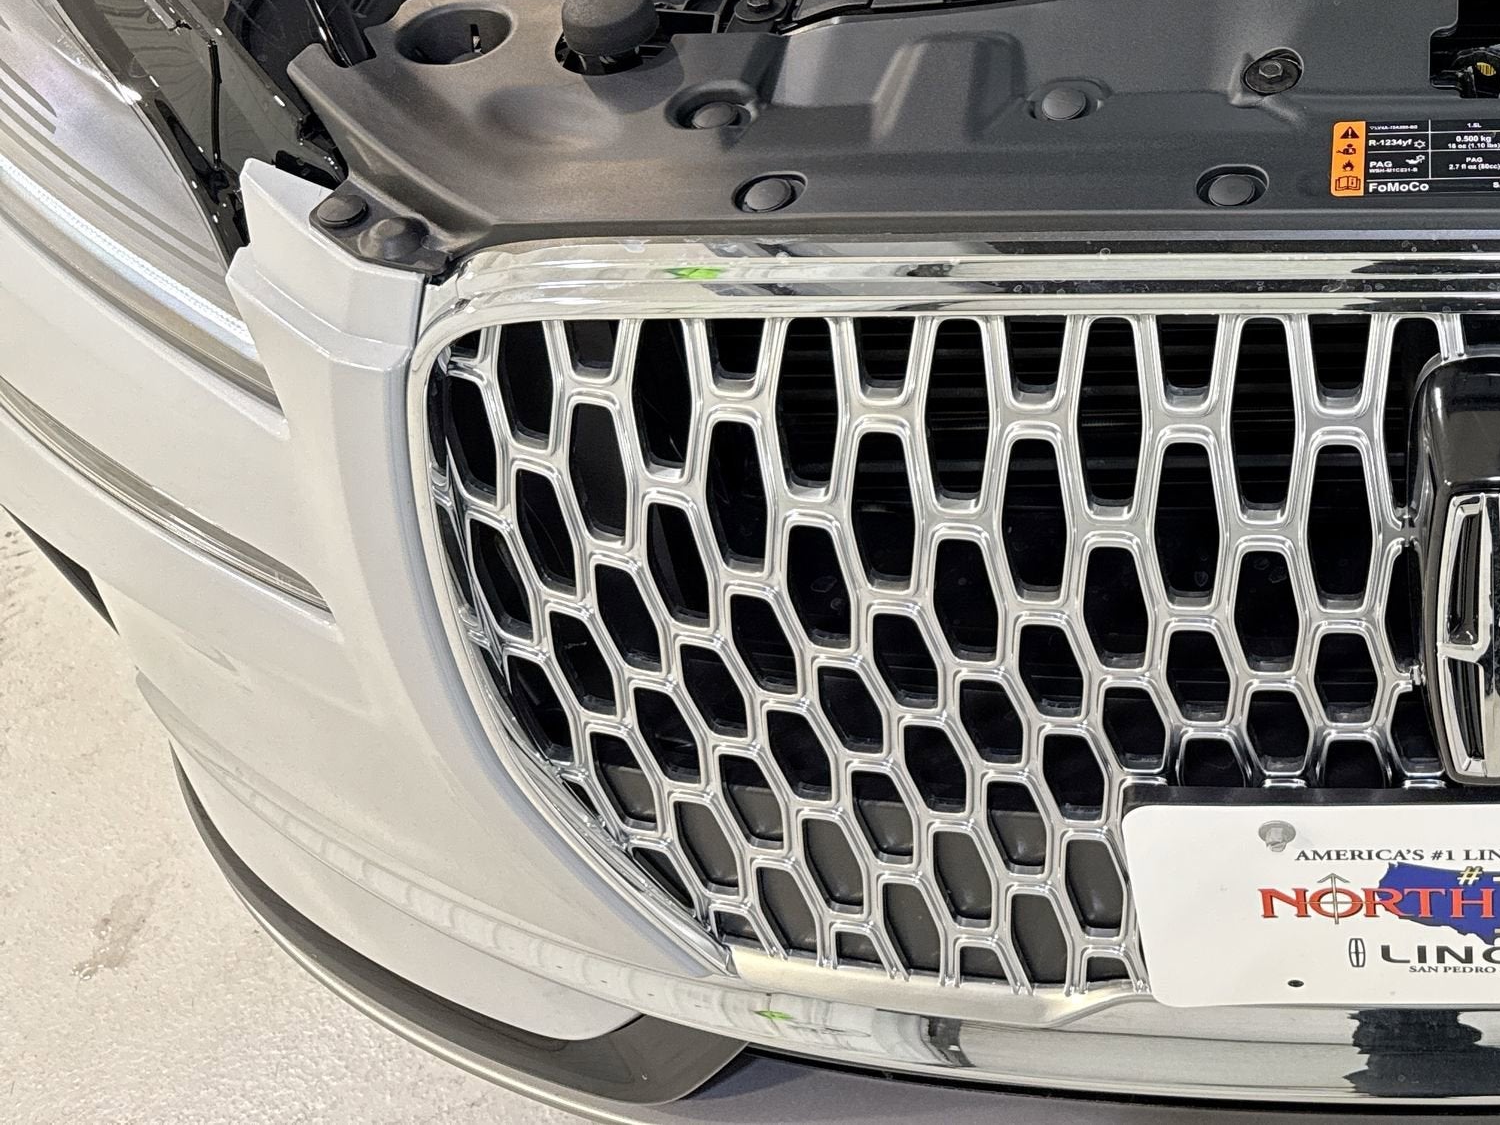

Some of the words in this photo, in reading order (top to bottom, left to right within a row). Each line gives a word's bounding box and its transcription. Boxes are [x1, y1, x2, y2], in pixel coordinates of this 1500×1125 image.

[1368, 138, 1412, 147] R-1234yf
[1480, 135, 1492, 143] kg
[1368, 181, 1429, 193] FoMoCo
[1295, 849, 1425, 861] AMERICA'S
[1430, 849, 1456, 861] #1
[1257, 887, 1496, 919] NORTH
[1408, 965, 1439, 973] SAN
[1443, 965, 1497, 973] PEDRO
